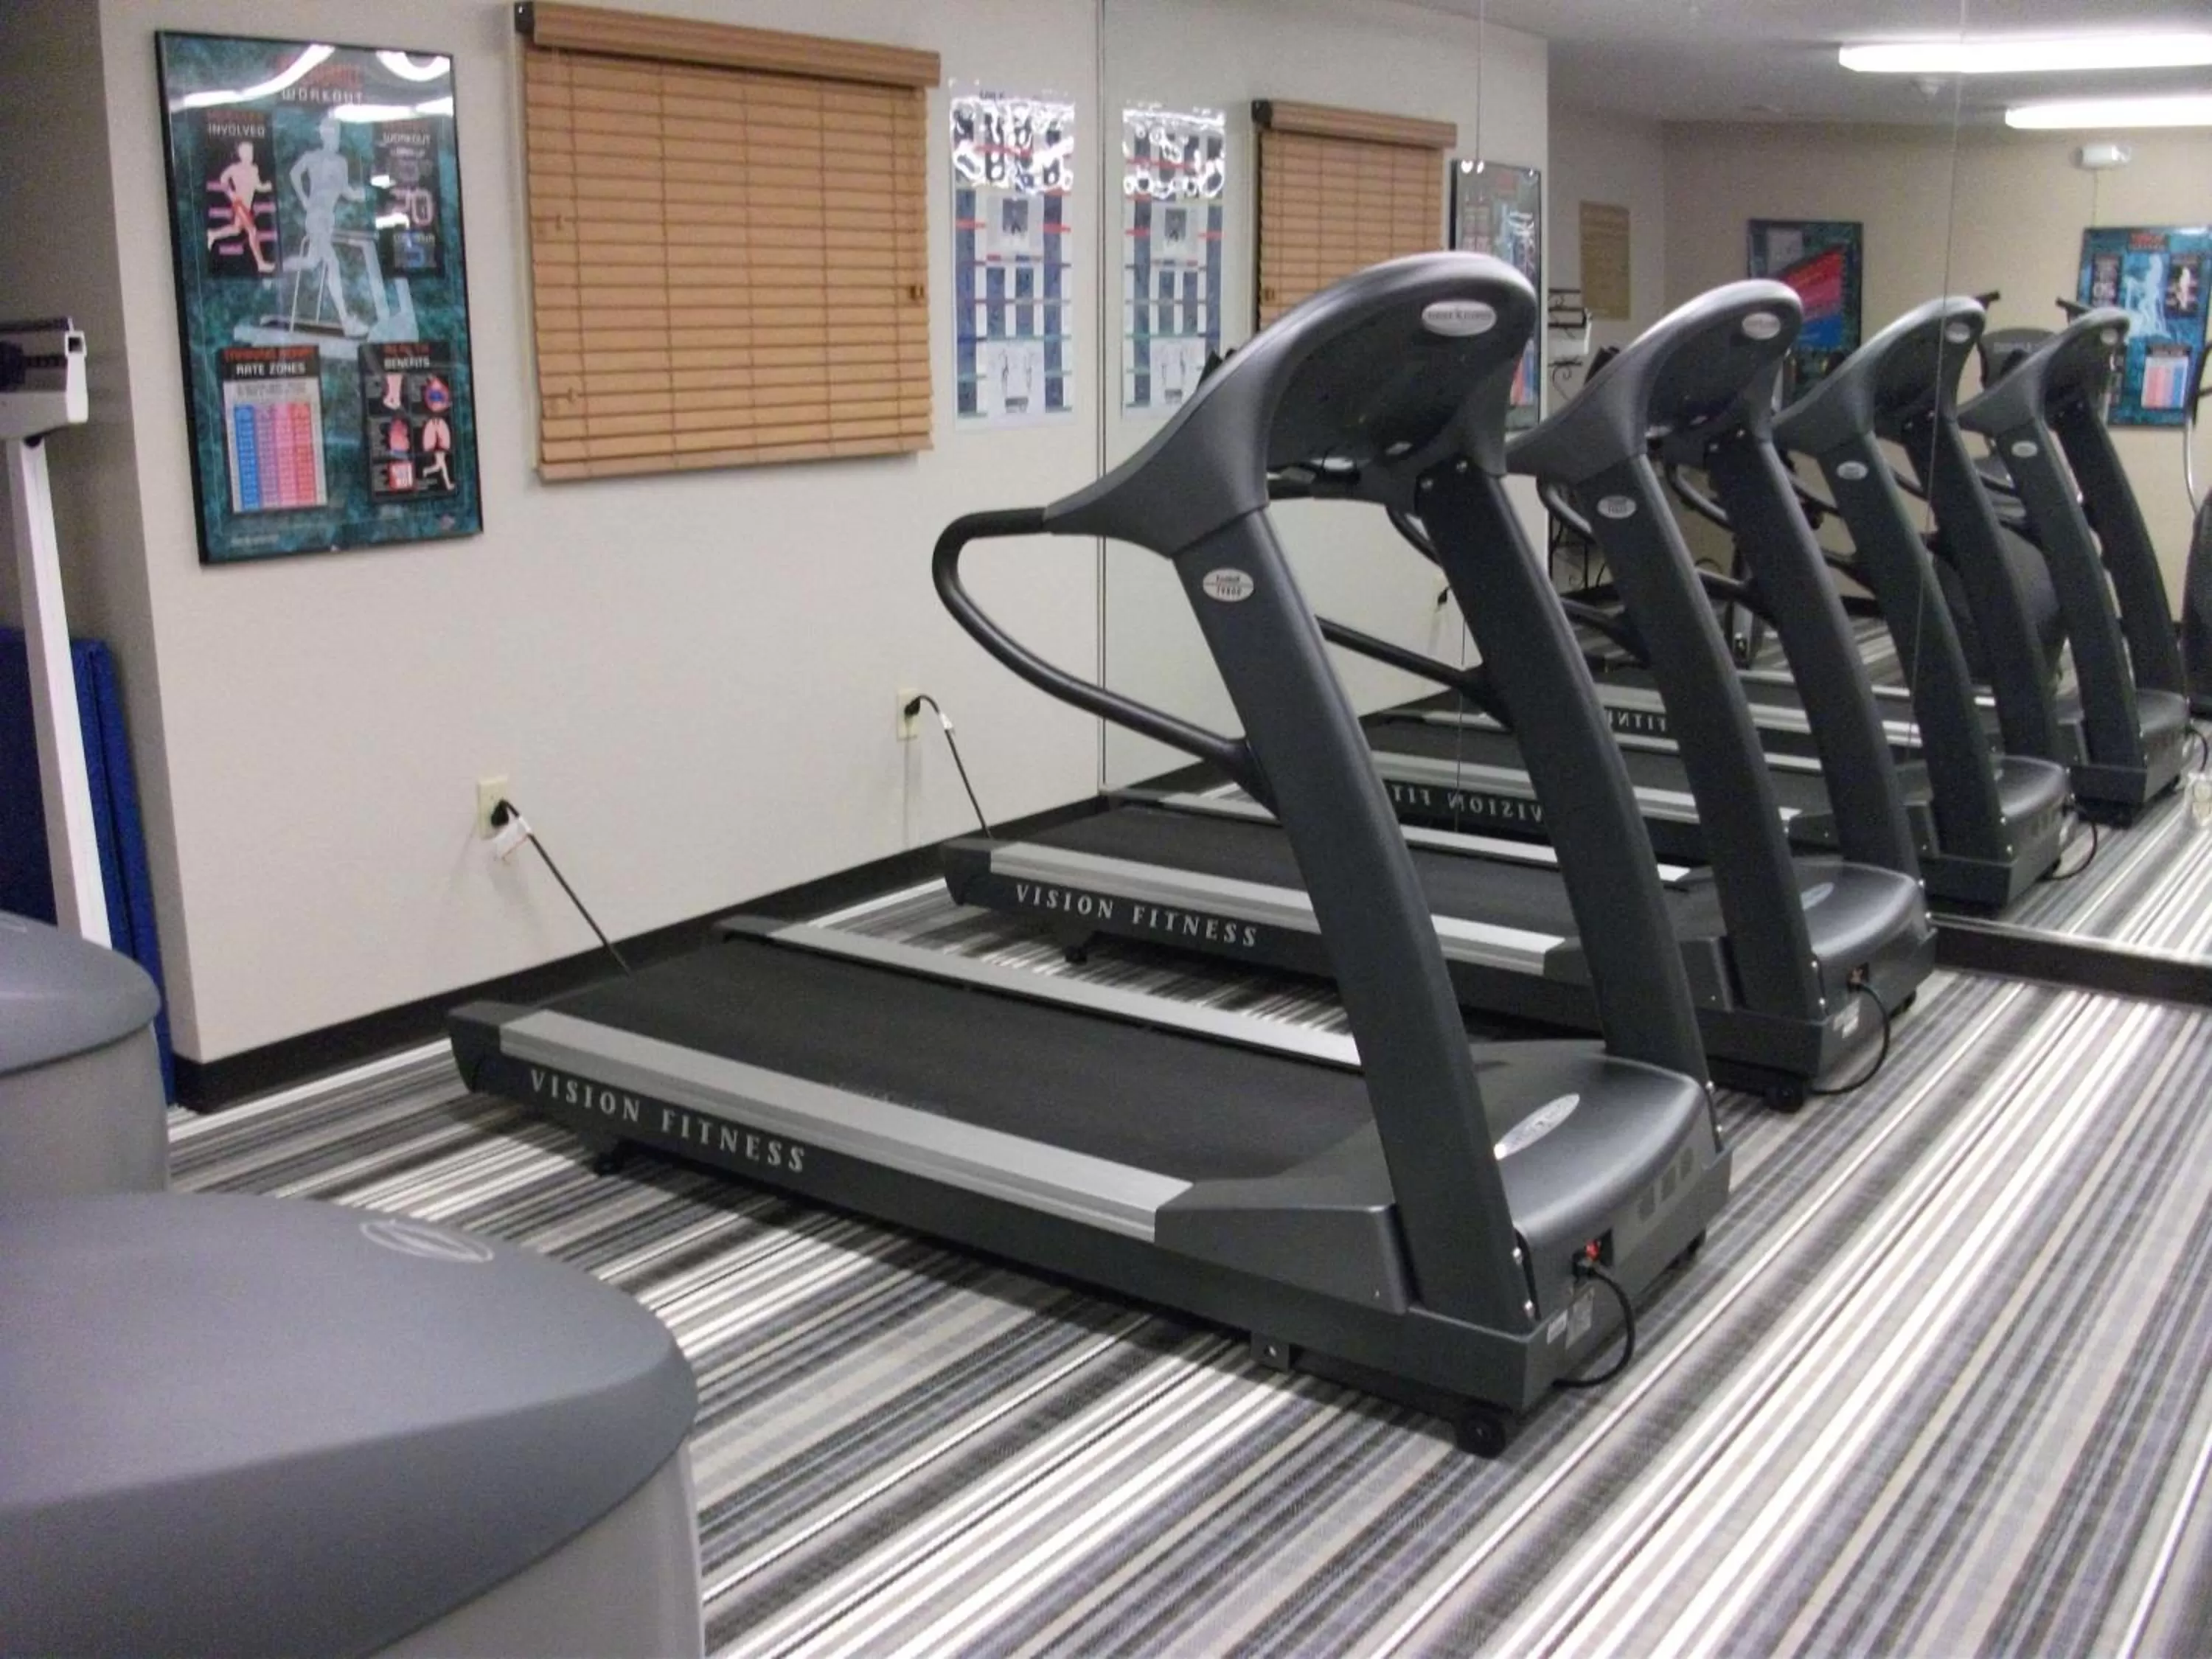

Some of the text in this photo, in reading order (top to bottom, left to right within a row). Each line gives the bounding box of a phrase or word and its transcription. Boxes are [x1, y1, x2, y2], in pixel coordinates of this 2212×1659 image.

[208, 122, 265, 139] INVOLVED
[1015, 884, 1257, 947] VISION FITNESS
[530, 1068, 805, 1173] VISION FITNESS
